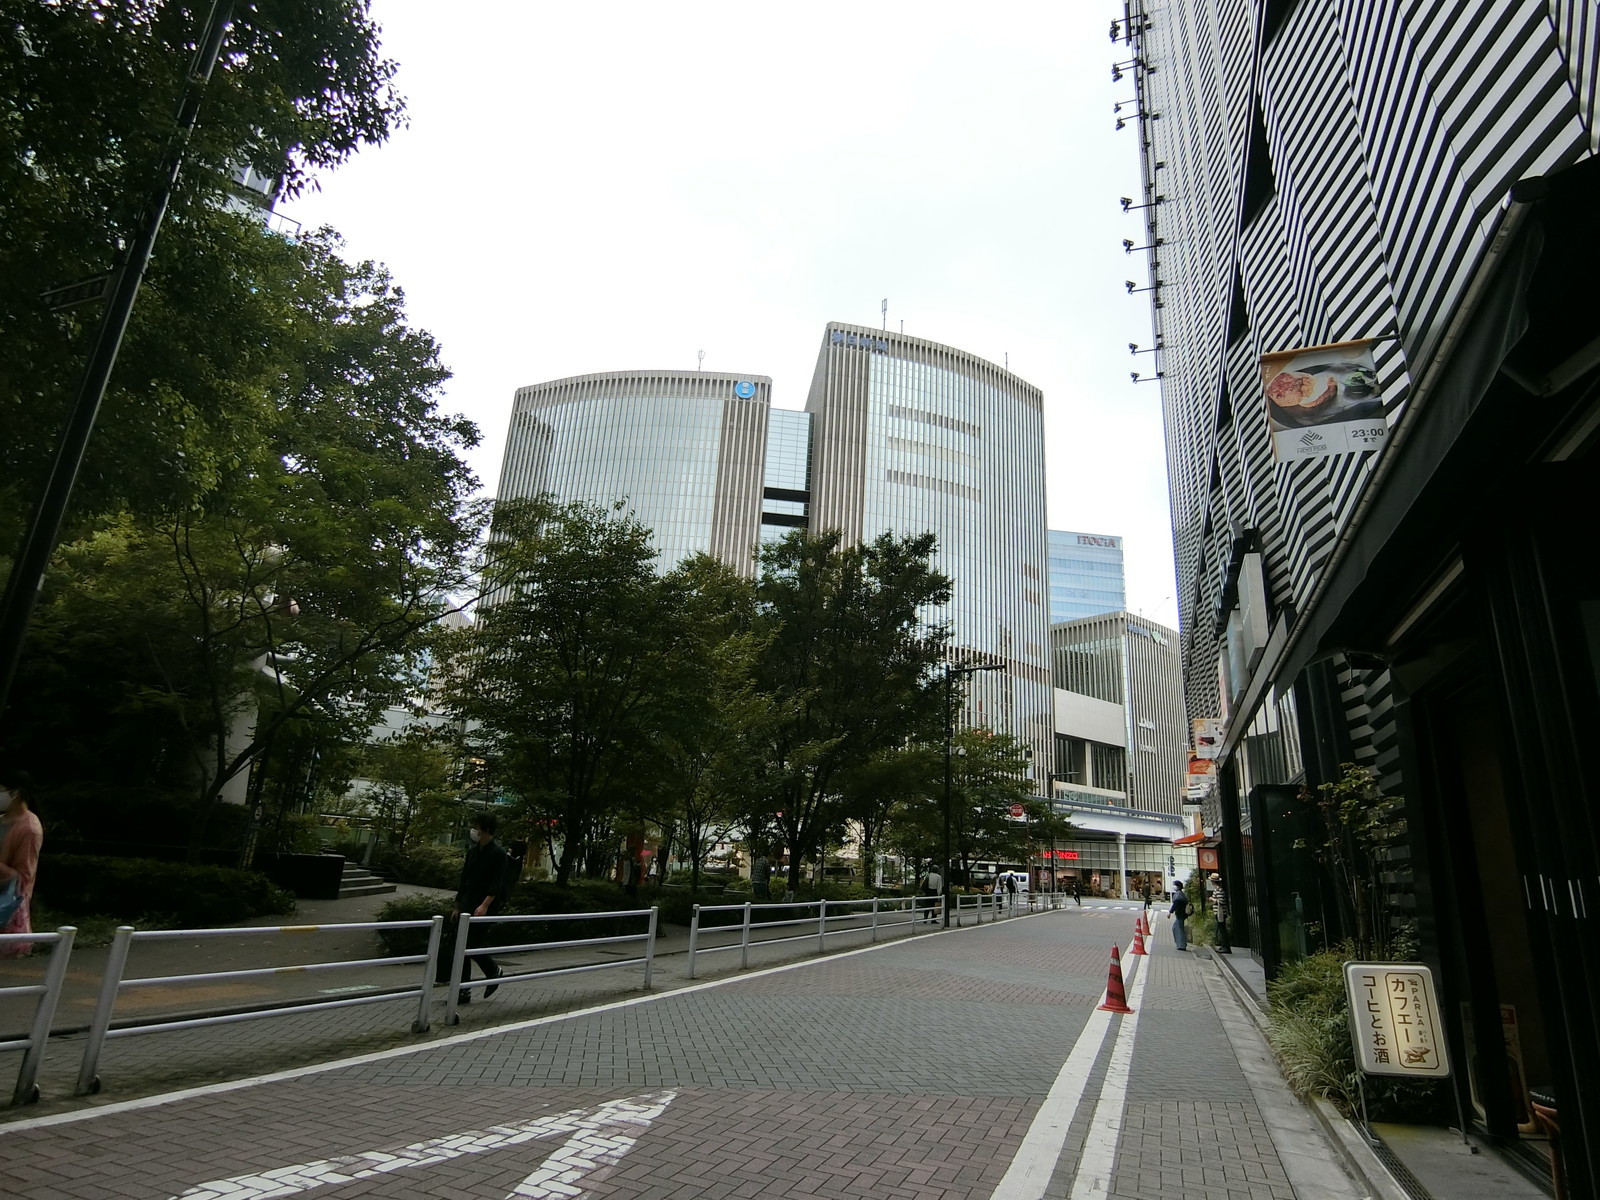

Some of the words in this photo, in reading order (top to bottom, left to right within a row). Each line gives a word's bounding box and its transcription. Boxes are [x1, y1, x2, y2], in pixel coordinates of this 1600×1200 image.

[1351, 428, 1384, 438] 23:00
[1362, 975, 1390, 1064] コーヒとお酒
[1411, 987, 1425, 1026] PARLA
